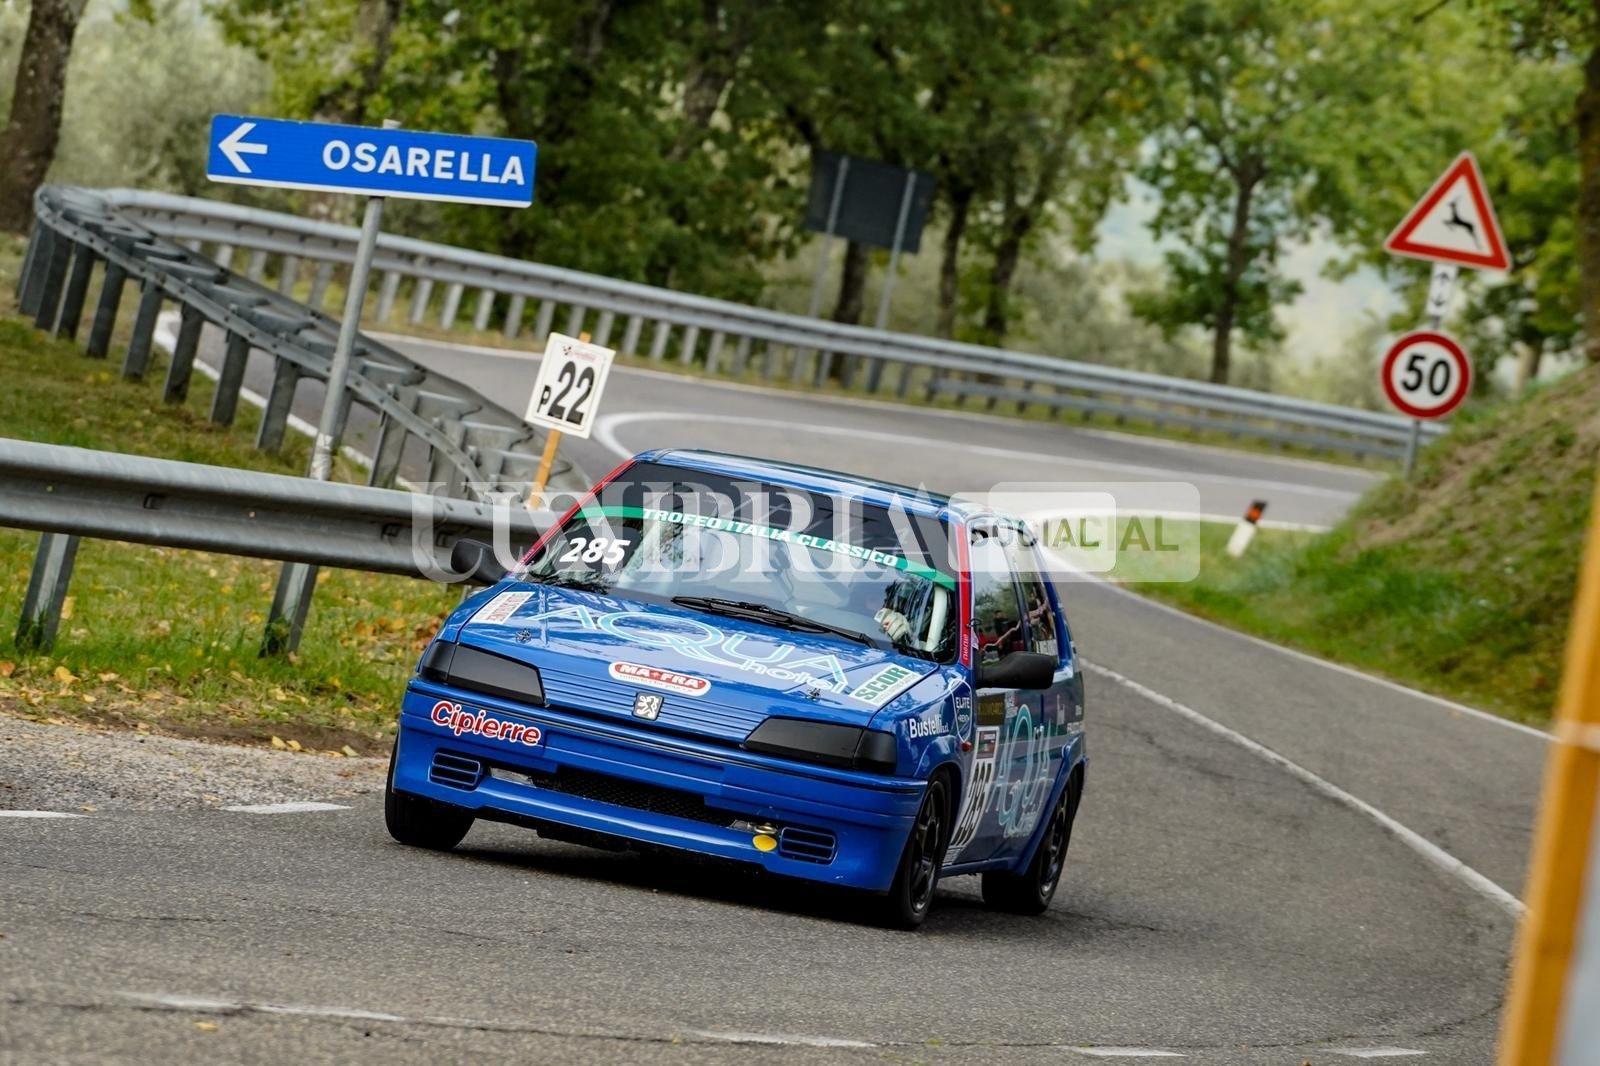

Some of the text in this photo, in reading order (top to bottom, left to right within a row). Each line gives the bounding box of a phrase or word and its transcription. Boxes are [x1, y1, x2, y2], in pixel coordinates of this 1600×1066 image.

[322, 139, 525, 186] OSARELLA
[1401, 353, 1450, 396] 50
[559, 536, 631, 565] 285
[643, 507, 899, 568] TROFEO ITALIA CLASSICO
[854, 665, 910, 701] SCOR
[430, 700, 542, 747] Cipierre
[908, 714, 943, 739] Bustelli
